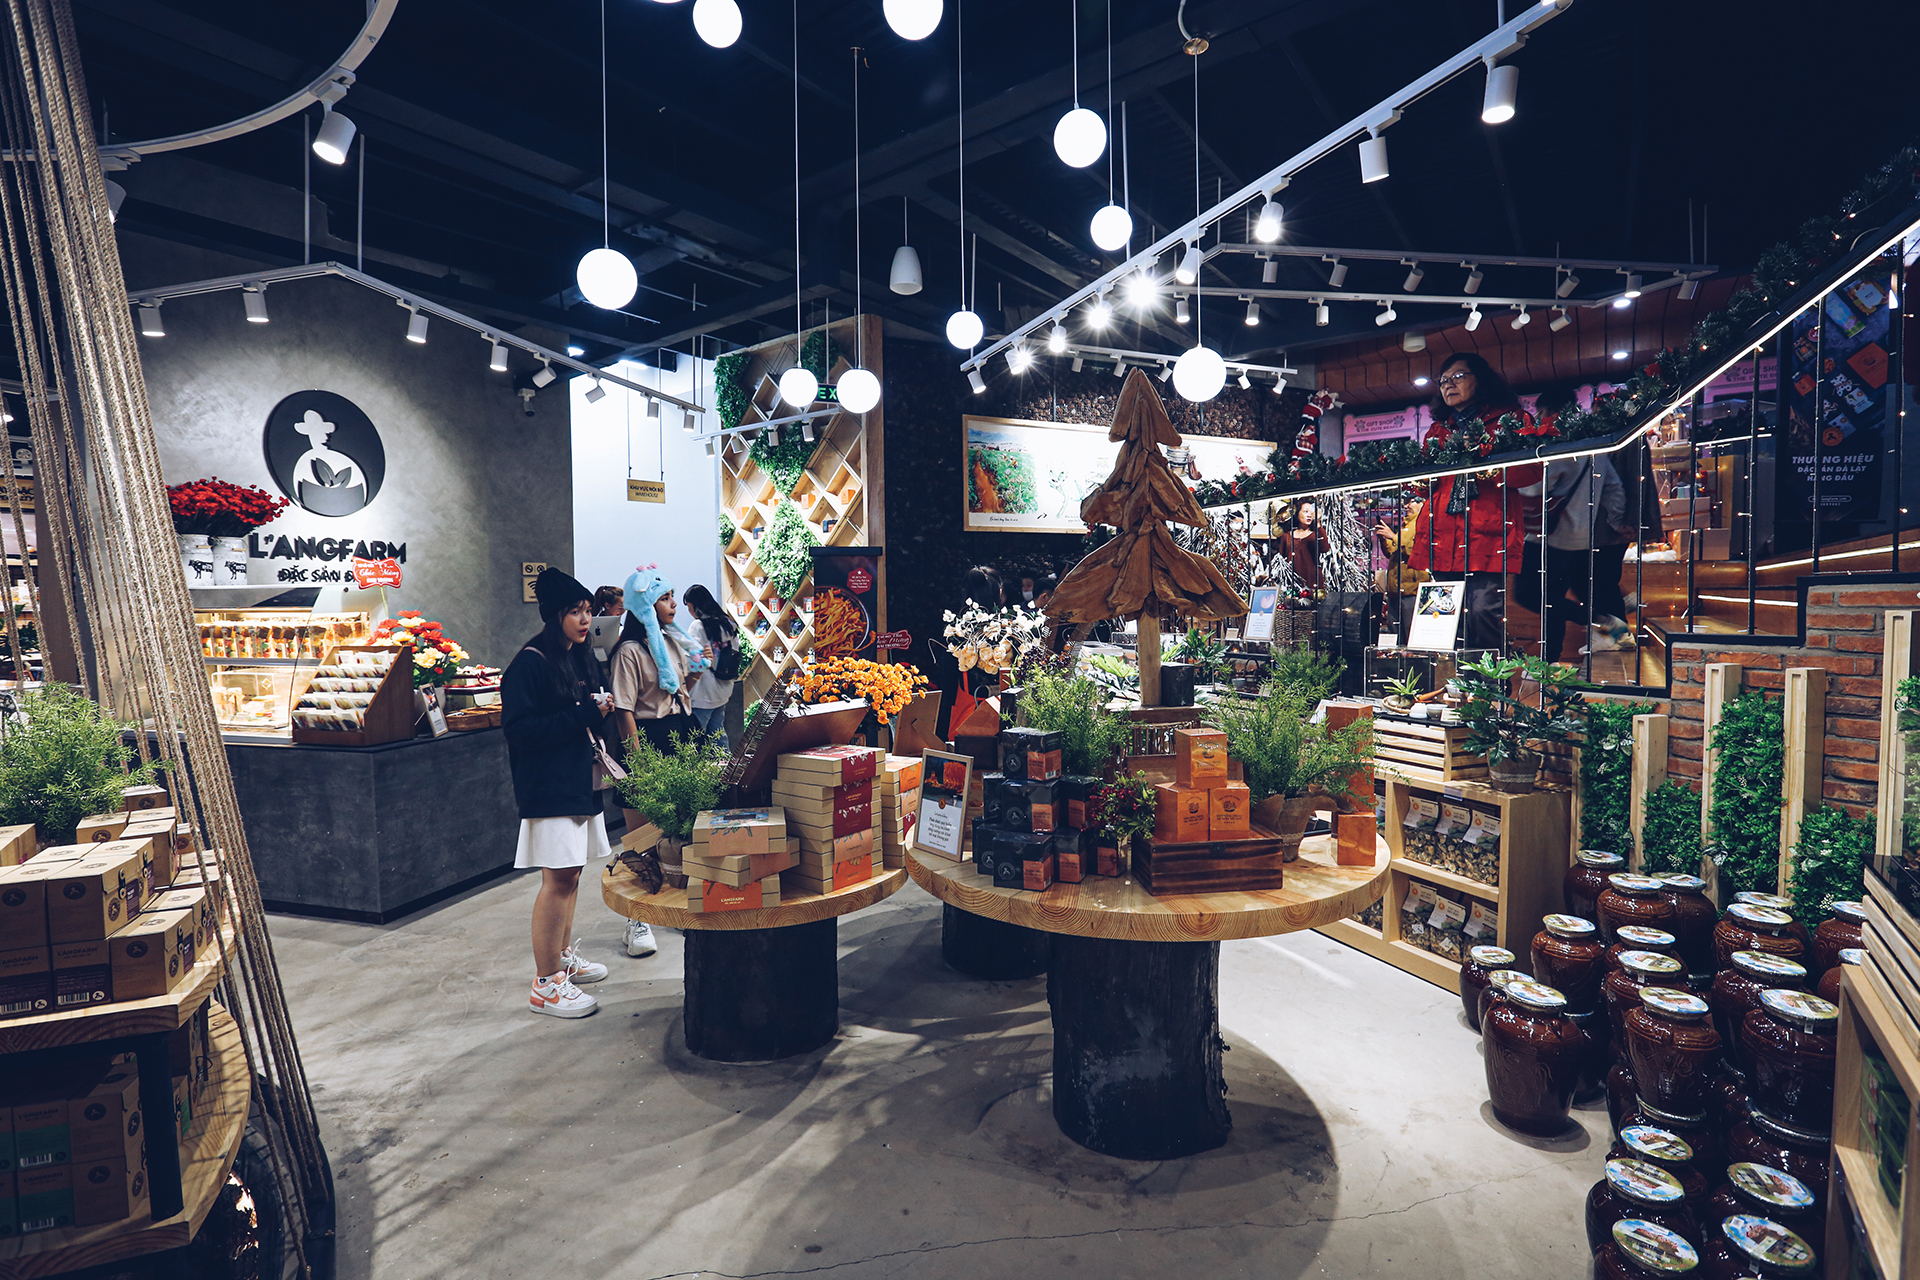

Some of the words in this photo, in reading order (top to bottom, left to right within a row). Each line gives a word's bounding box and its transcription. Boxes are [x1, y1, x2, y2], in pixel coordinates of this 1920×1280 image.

[818, 387, 838, 400] EX
[248, 532, 407, 564] L'ANGFARM
[277, 564, 309, 584] ĐẶC
